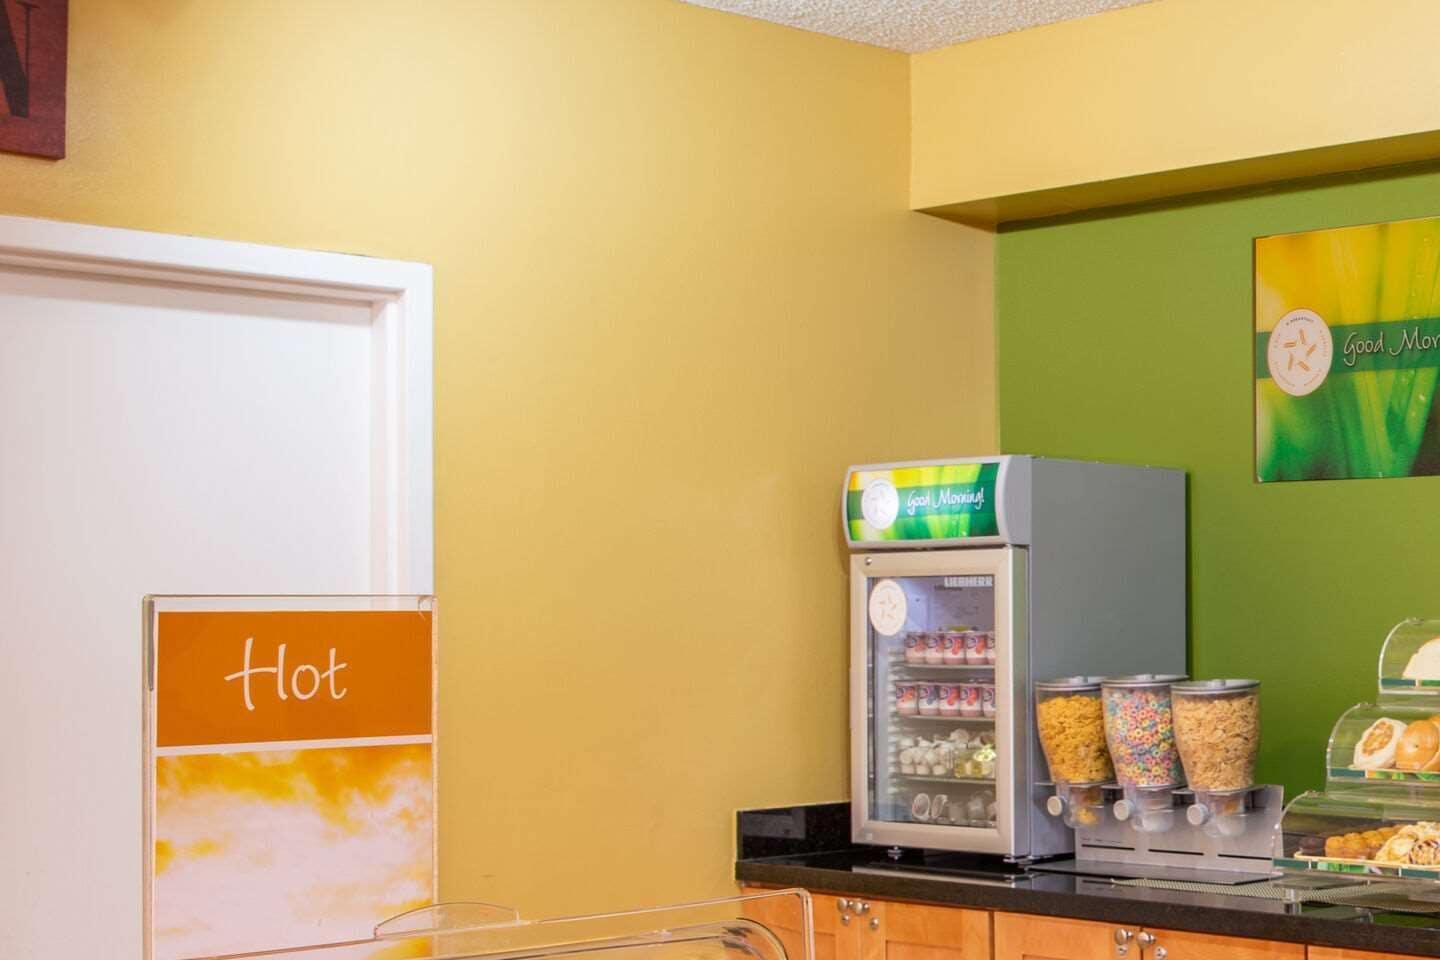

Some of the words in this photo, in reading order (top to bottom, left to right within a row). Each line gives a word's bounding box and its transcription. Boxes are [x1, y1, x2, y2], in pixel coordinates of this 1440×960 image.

[1343, 331, 1384, 367] Good
[906, 490, 930, 516] Good
[932, 487, 985, 511] Morning!
[224, 637, 348, 712] Hot
